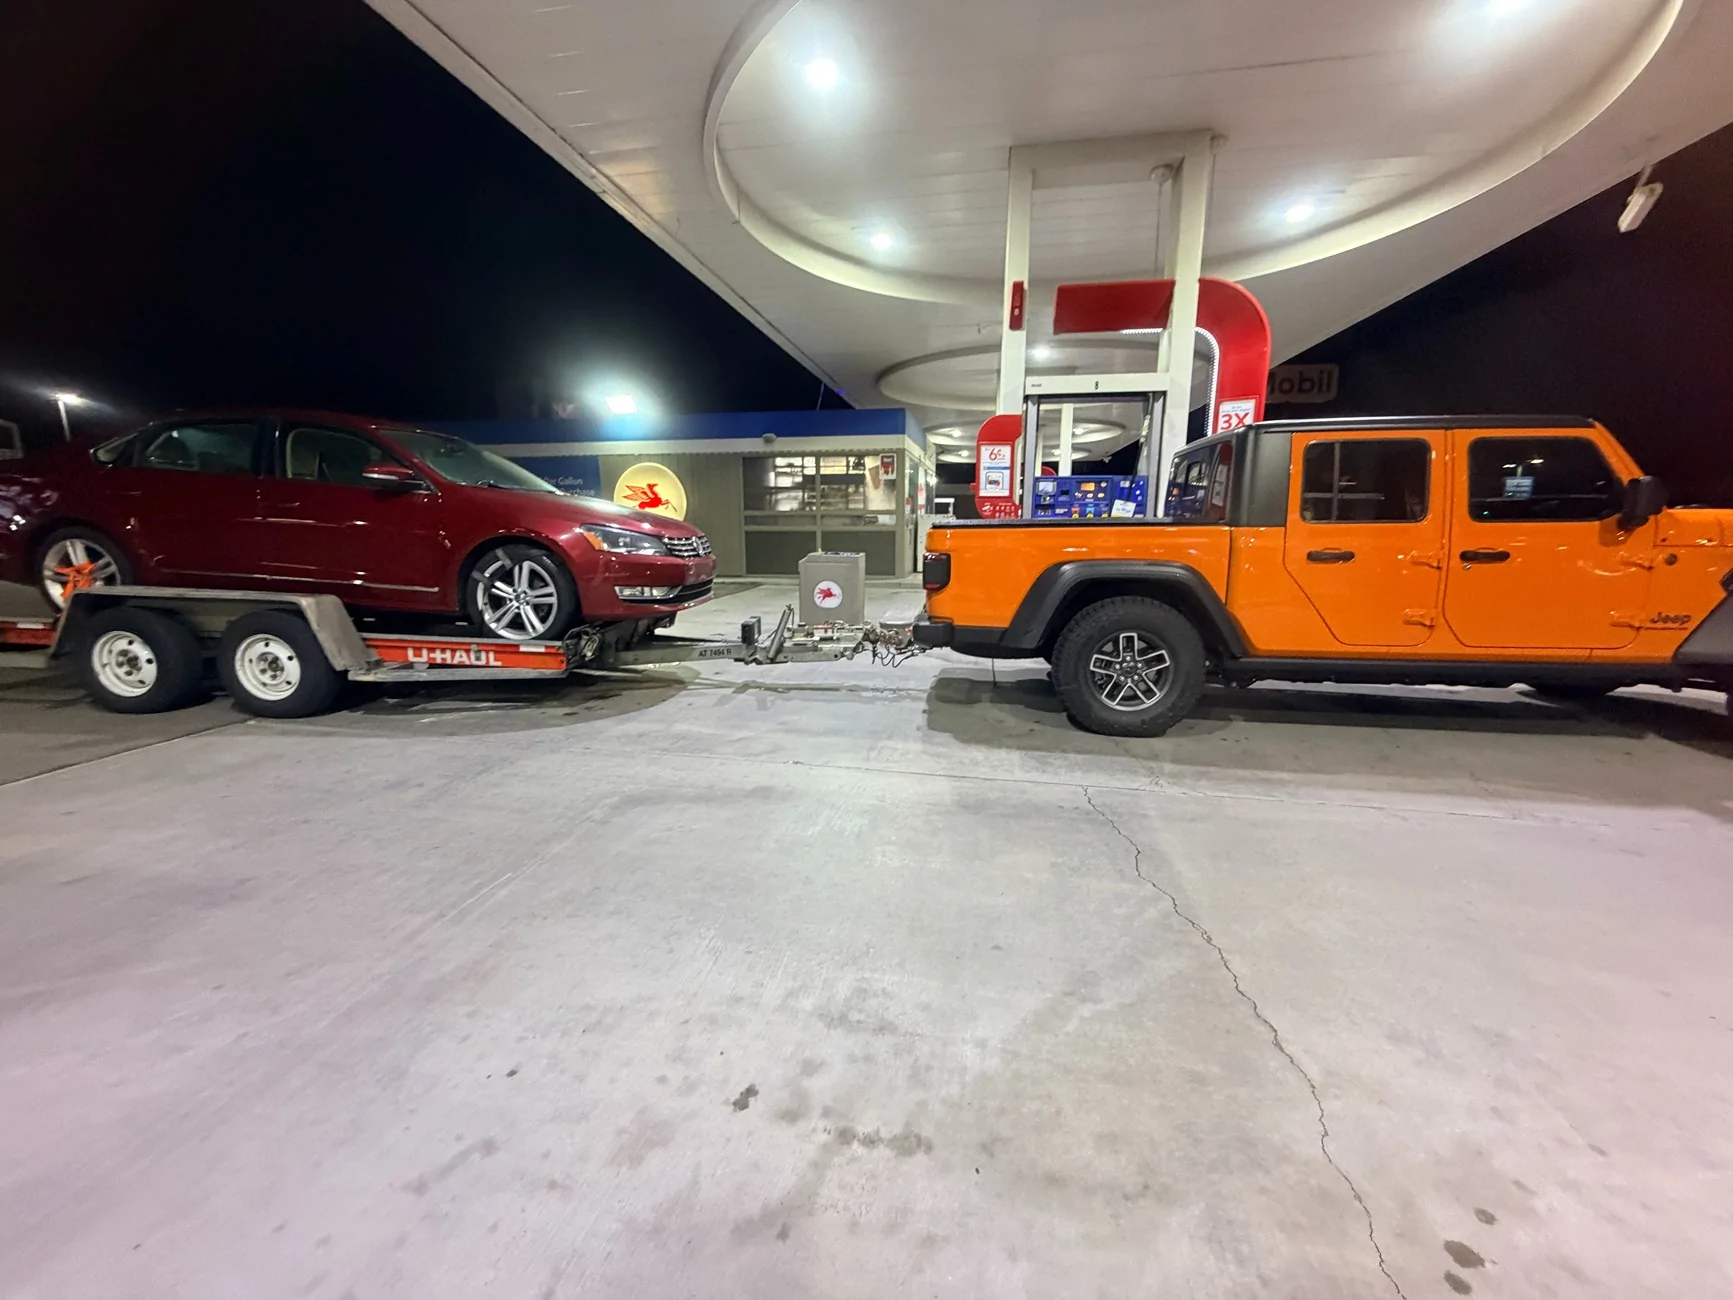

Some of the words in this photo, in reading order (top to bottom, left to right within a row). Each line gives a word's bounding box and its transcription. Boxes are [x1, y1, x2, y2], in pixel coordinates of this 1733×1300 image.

[1221, 412, 1250, 430] 3X
[1650, 611, 1691, 626] Jeep
[407, 647, 502, 667] U-HAUL
